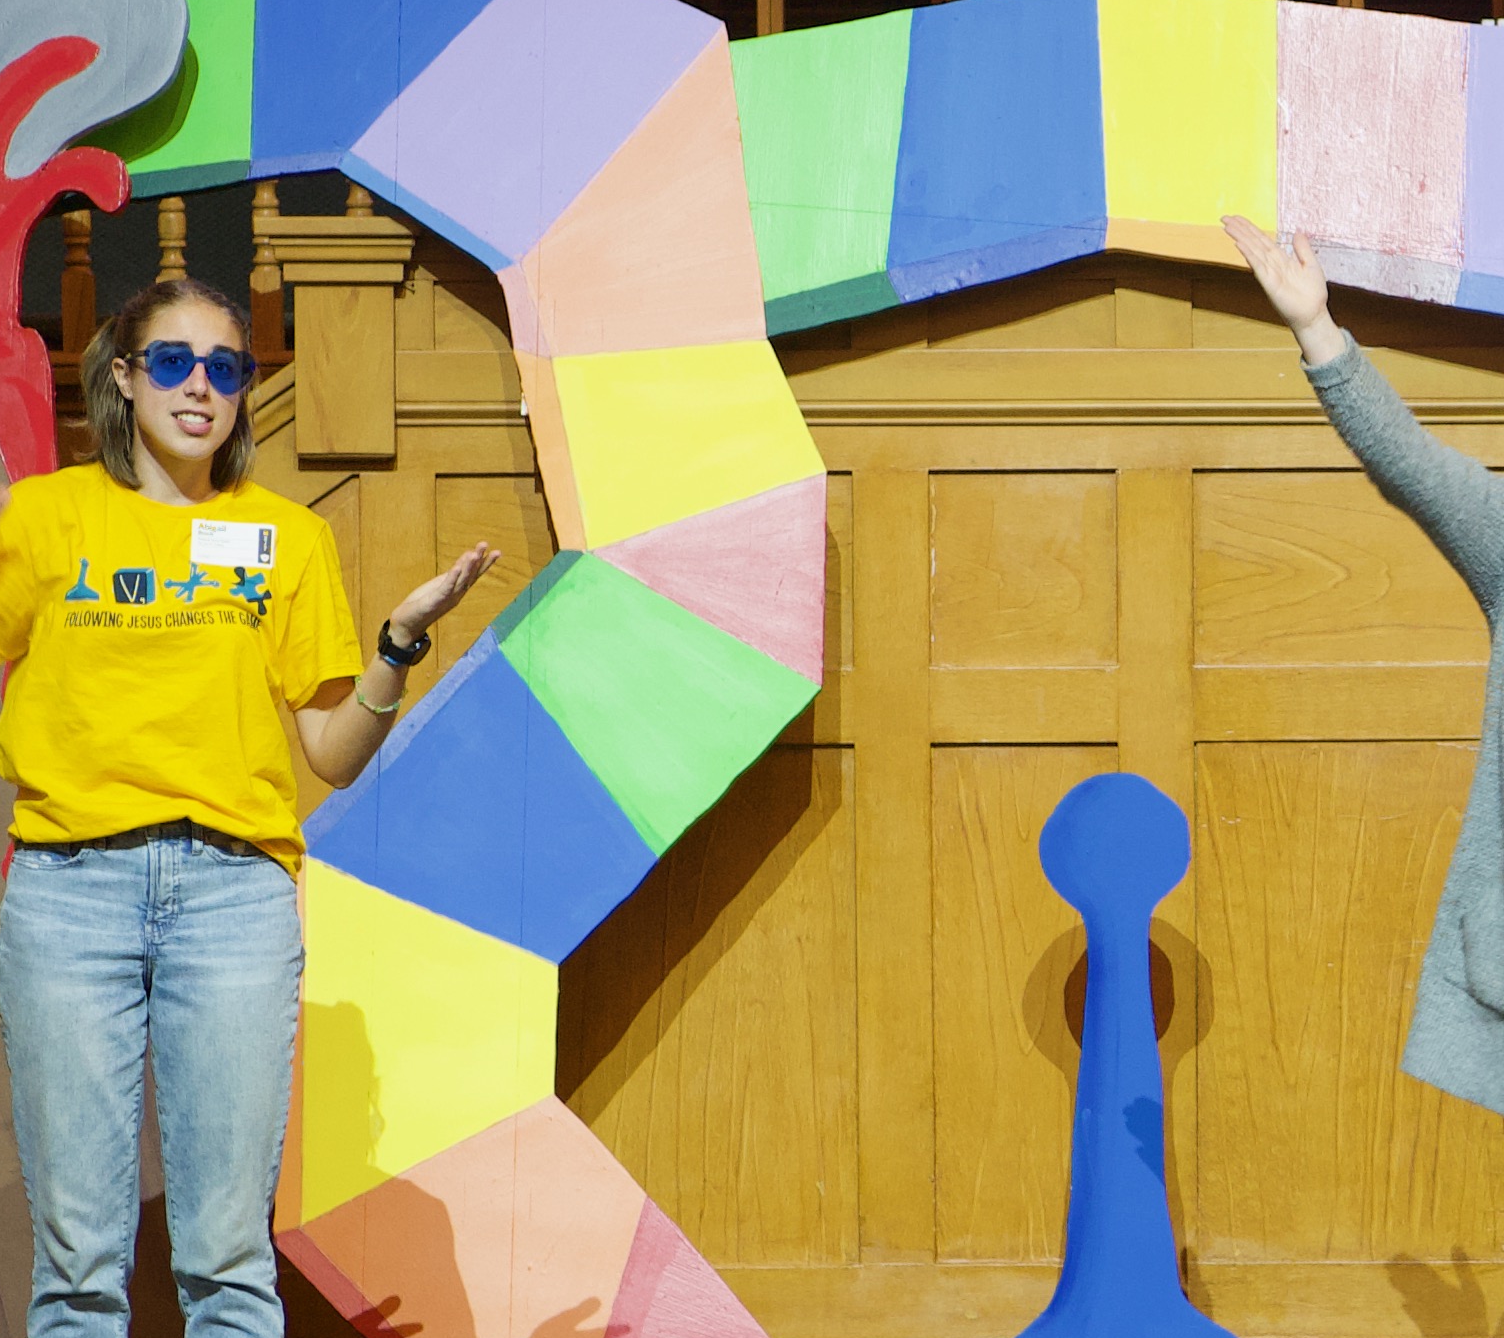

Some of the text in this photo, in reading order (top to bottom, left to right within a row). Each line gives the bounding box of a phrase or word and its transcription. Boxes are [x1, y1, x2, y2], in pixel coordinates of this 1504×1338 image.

[64, 610, 123, 628] FOLLOWING
[127, 613, 162, 628] JESUS
[165, 611, 215, 628] CHANGES
[218, 610, 236, 624] THE
